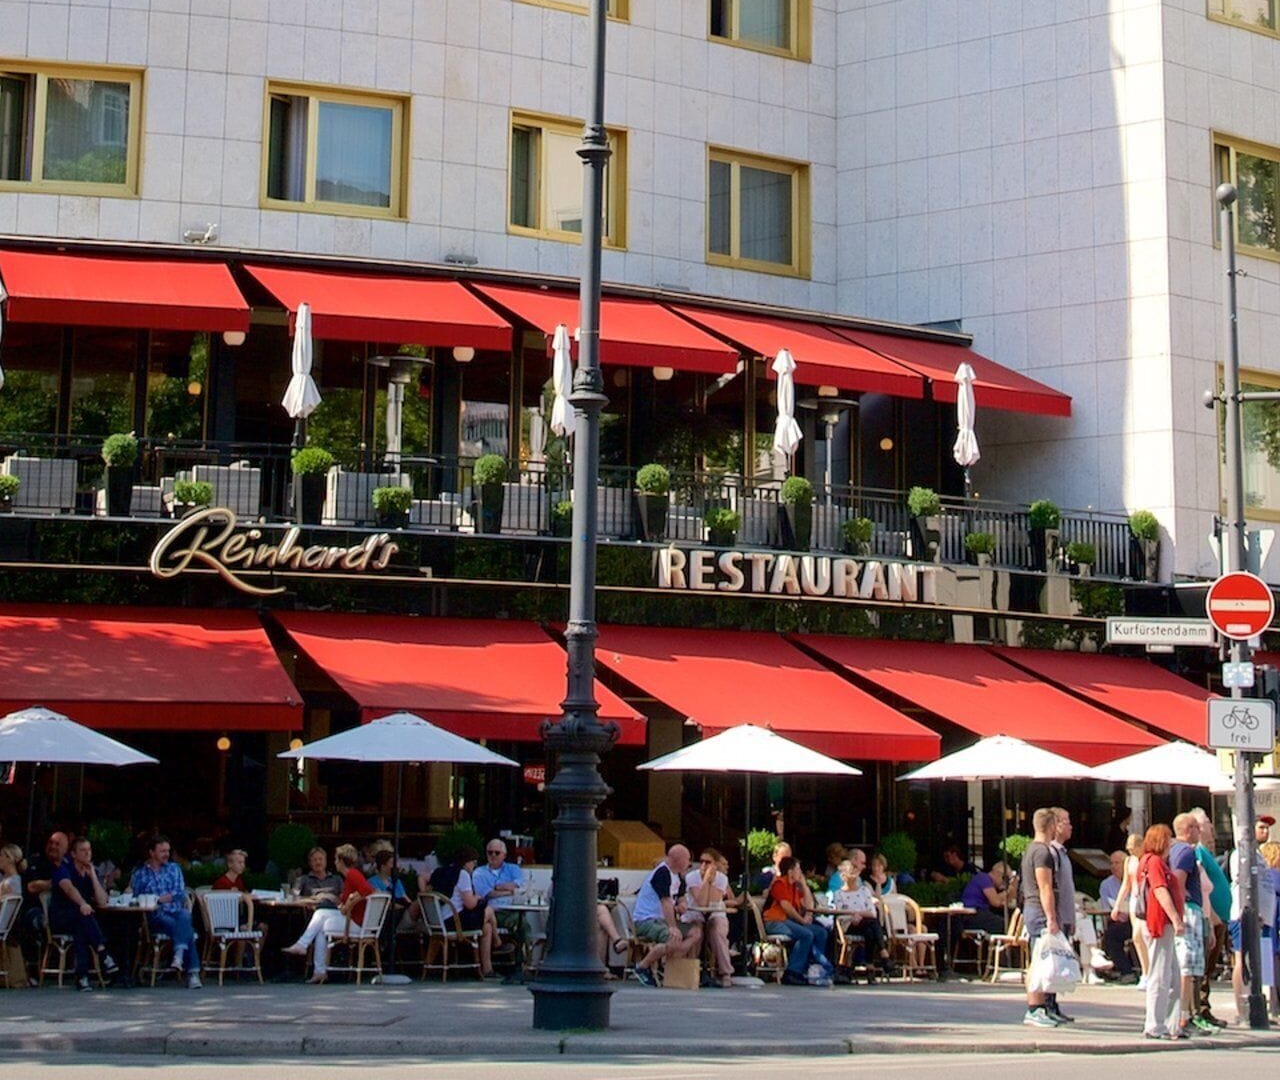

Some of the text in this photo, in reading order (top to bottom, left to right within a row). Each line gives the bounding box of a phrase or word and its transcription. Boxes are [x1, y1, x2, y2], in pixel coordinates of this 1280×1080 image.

[150, 507, 399, 597] Reinhard's
[657, 547, 938, 604] RESTAURANT
[1114, 623, 1208, 637] Kurfürstendamm
[1230, 732, 1252, 744] frei
